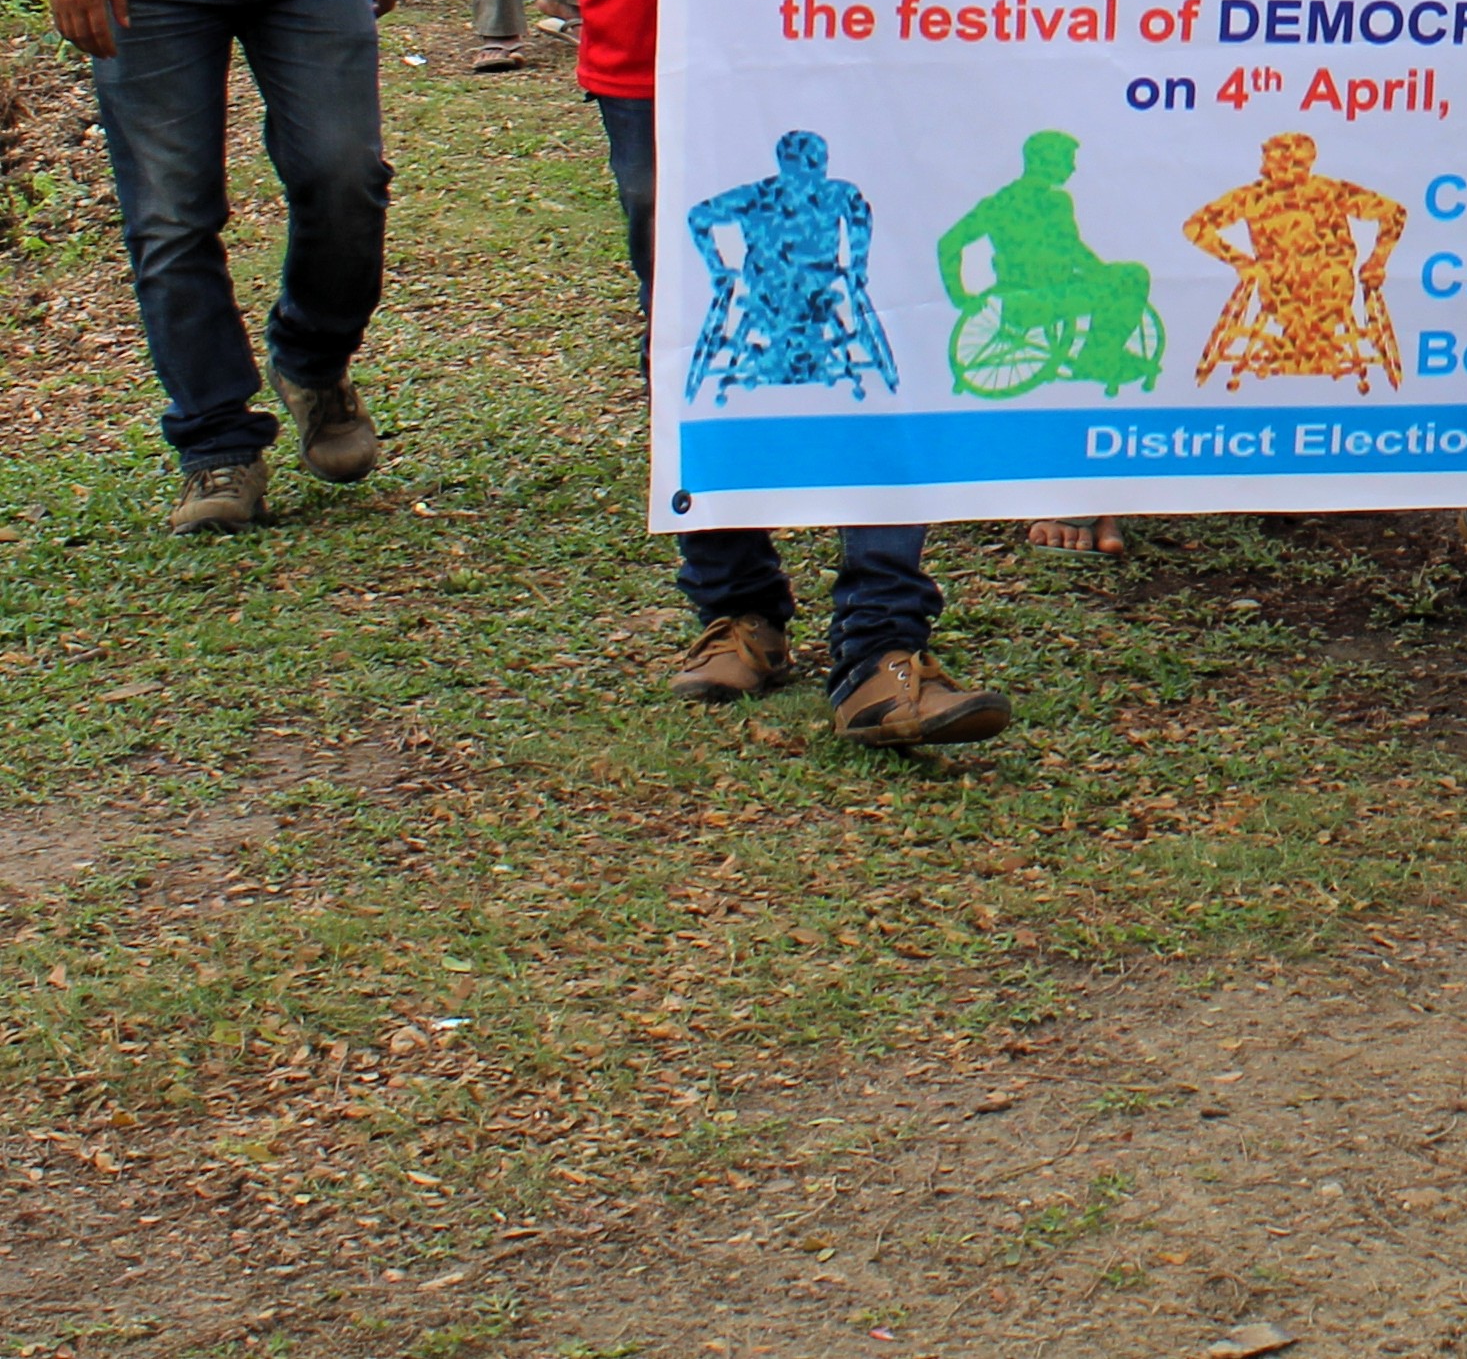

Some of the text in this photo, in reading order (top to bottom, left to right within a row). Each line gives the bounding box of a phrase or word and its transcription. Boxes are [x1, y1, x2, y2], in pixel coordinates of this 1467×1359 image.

[1127, 78, 1195, 110] on
[1217, 67, 1282, 109] 4th
[1301, 69, 1448, 120] April,
[1087, 425, 1275, 457] District
